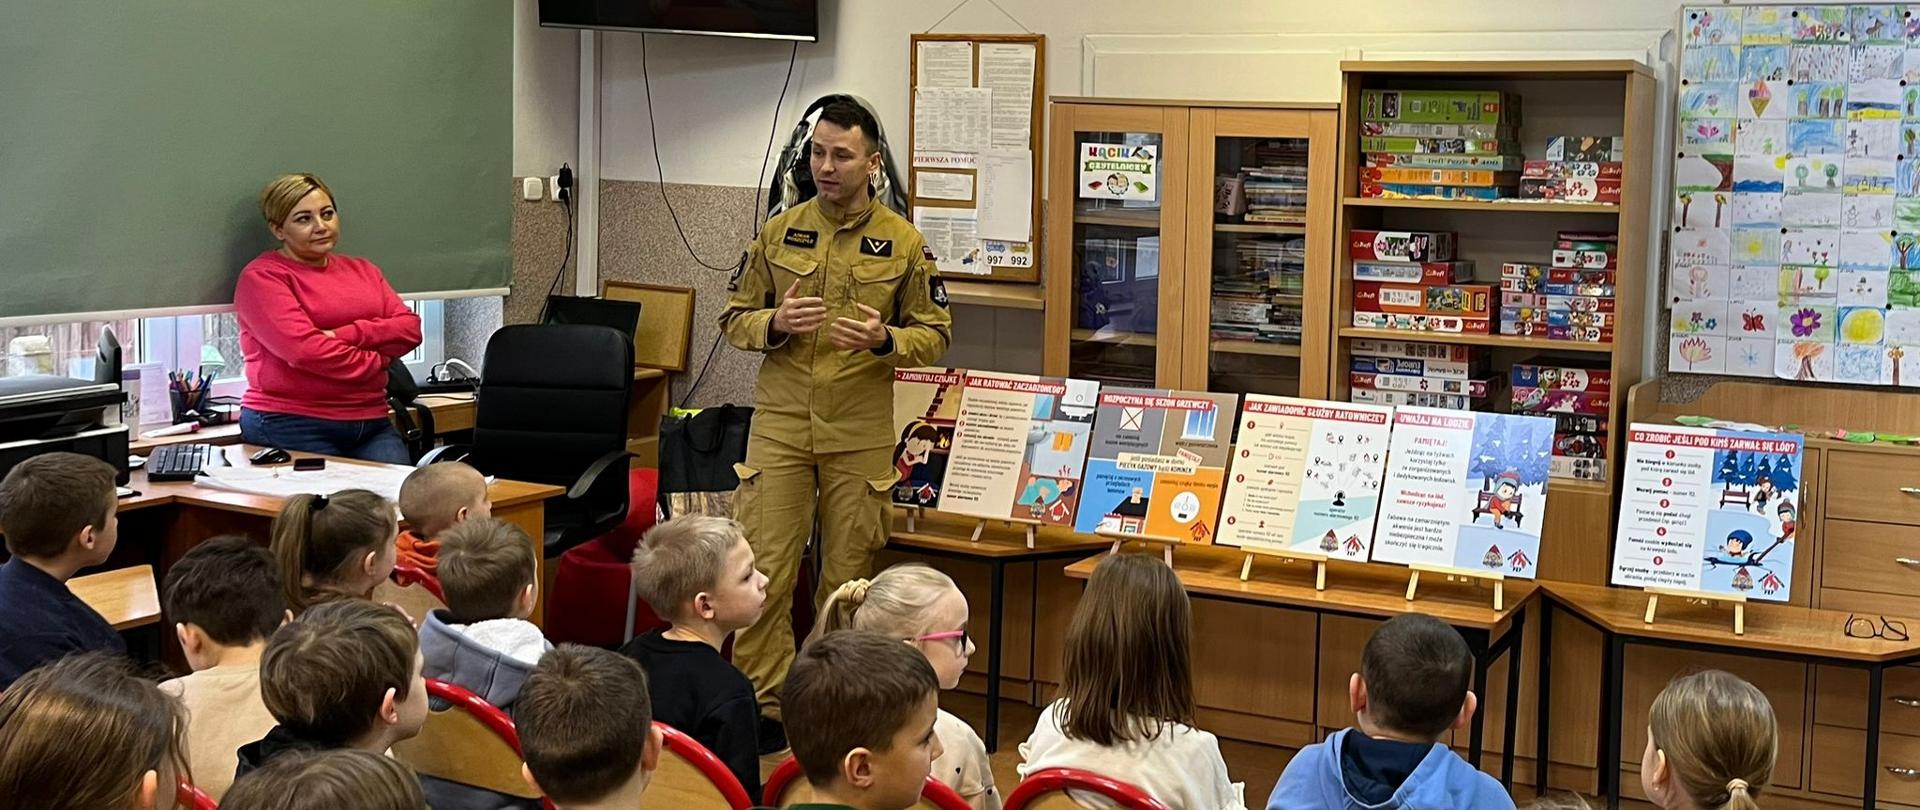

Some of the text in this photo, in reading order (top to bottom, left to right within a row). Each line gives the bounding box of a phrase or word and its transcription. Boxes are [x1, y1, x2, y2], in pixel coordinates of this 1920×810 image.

[987, 256, 1028, 266] 997 992
[902, 372, 934, 382] ZAMONTUJ
[984, 380, 1012, 390] RATOWAĆ
[1013, 382, 1065, 394] ZACZADZONEGO?
[1104, 394, 1210, 410] ROZPOCZYNA SIĘ SEZON GRZEWCZY
[1248, 402, 1384, 424] JAK ZAWIADOMIĆ SŁUŻBY RATOWNICZE?
[1400, 412, 1470, 429] UWAŻAJ NA LODZIE
[1634, 432, 1796, 453] CO ZROBIĆ JEŚLI POD KIMŚ ZARWAŁ SIĘ LÓD?
[1410, 458, 1432, 466] korzystaj
[1396, 472, 1433, 482] dedykowanych
[1408, 467, 1452, 475] zorganizowanych
